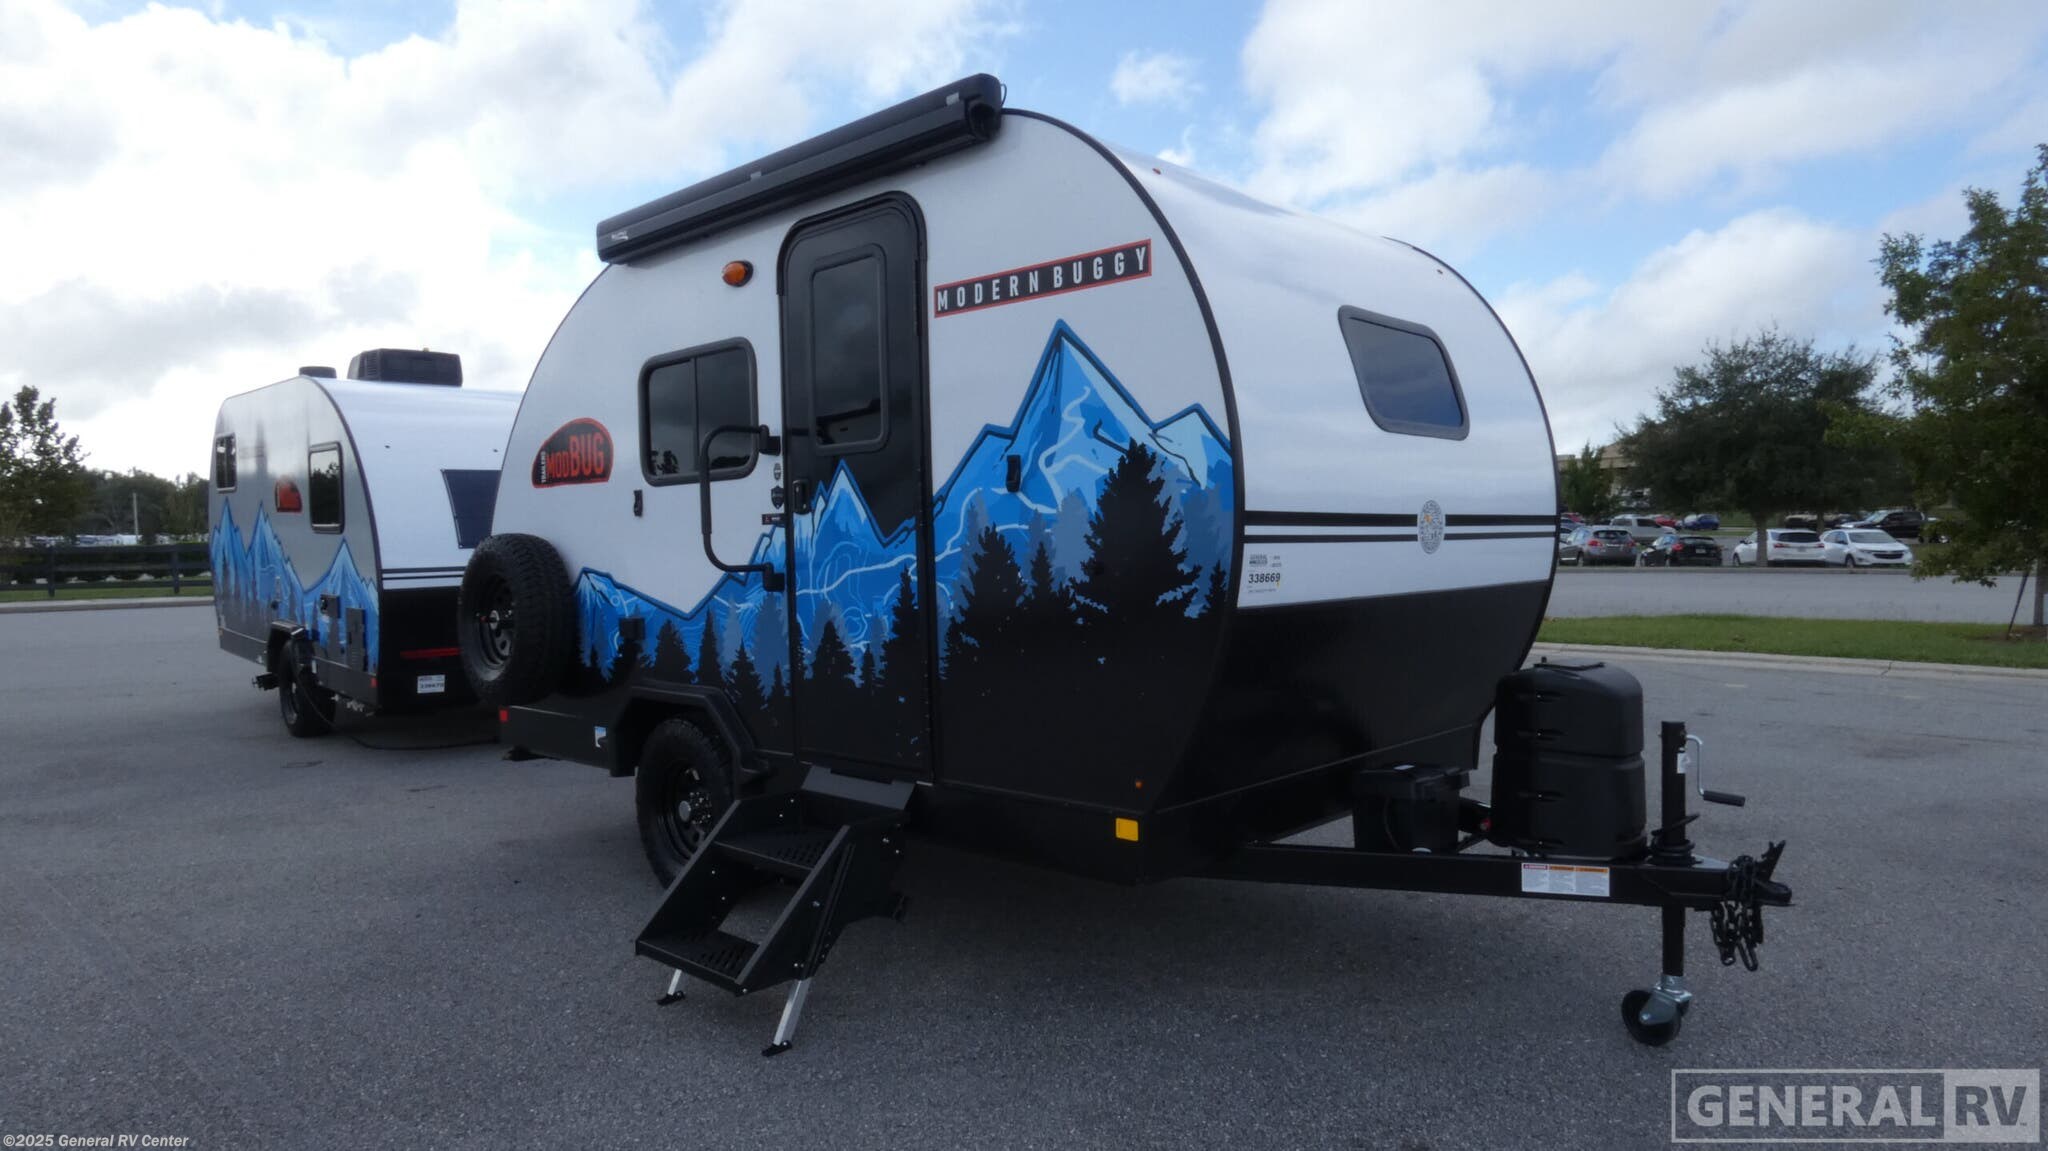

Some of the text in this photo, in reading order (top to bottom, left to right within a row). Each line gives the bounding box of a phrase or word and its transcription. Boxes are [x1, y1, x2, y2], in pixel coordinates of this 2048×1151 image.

[937, 246, 1146, 312] MODERN BUGGY
[1248, 572, 1281, 584] 338669
